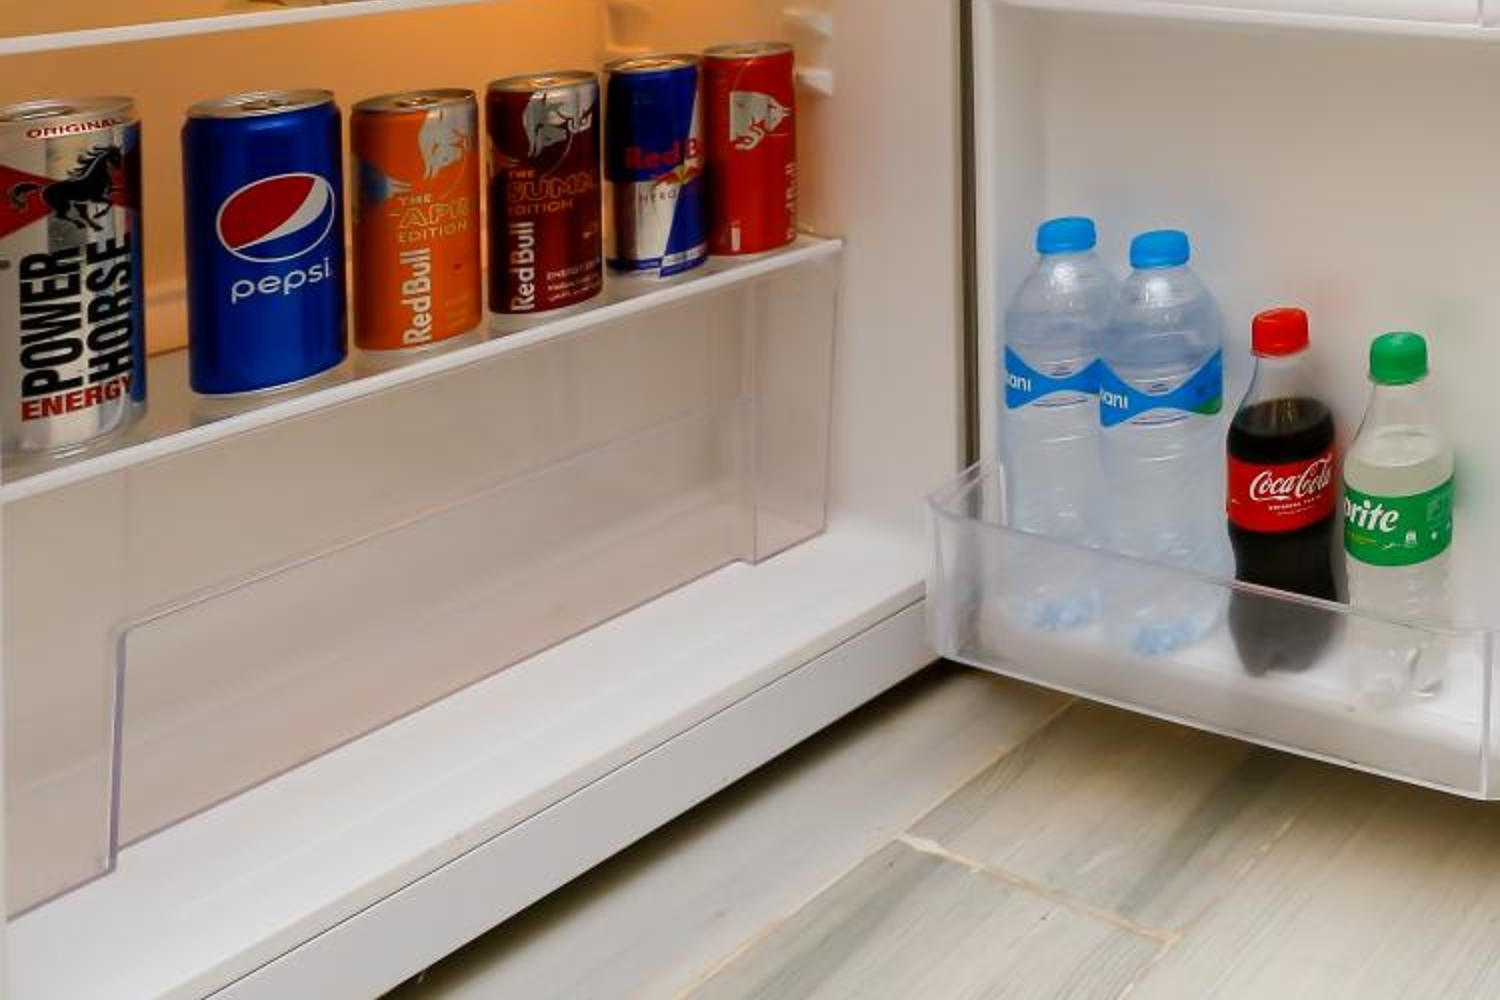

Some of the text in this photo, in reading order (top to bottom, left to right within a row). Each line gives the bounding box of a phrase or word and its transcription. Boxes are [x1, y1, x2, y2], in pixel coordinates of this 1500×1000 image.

[398, 218, 468, 244] EDITION
[231, 256, 330, 305] pepsi
[20, 246, 84, 398] POWER
[86, 232, 133, 384] HORSE
[21, 375, 134, 422] ENERGY
